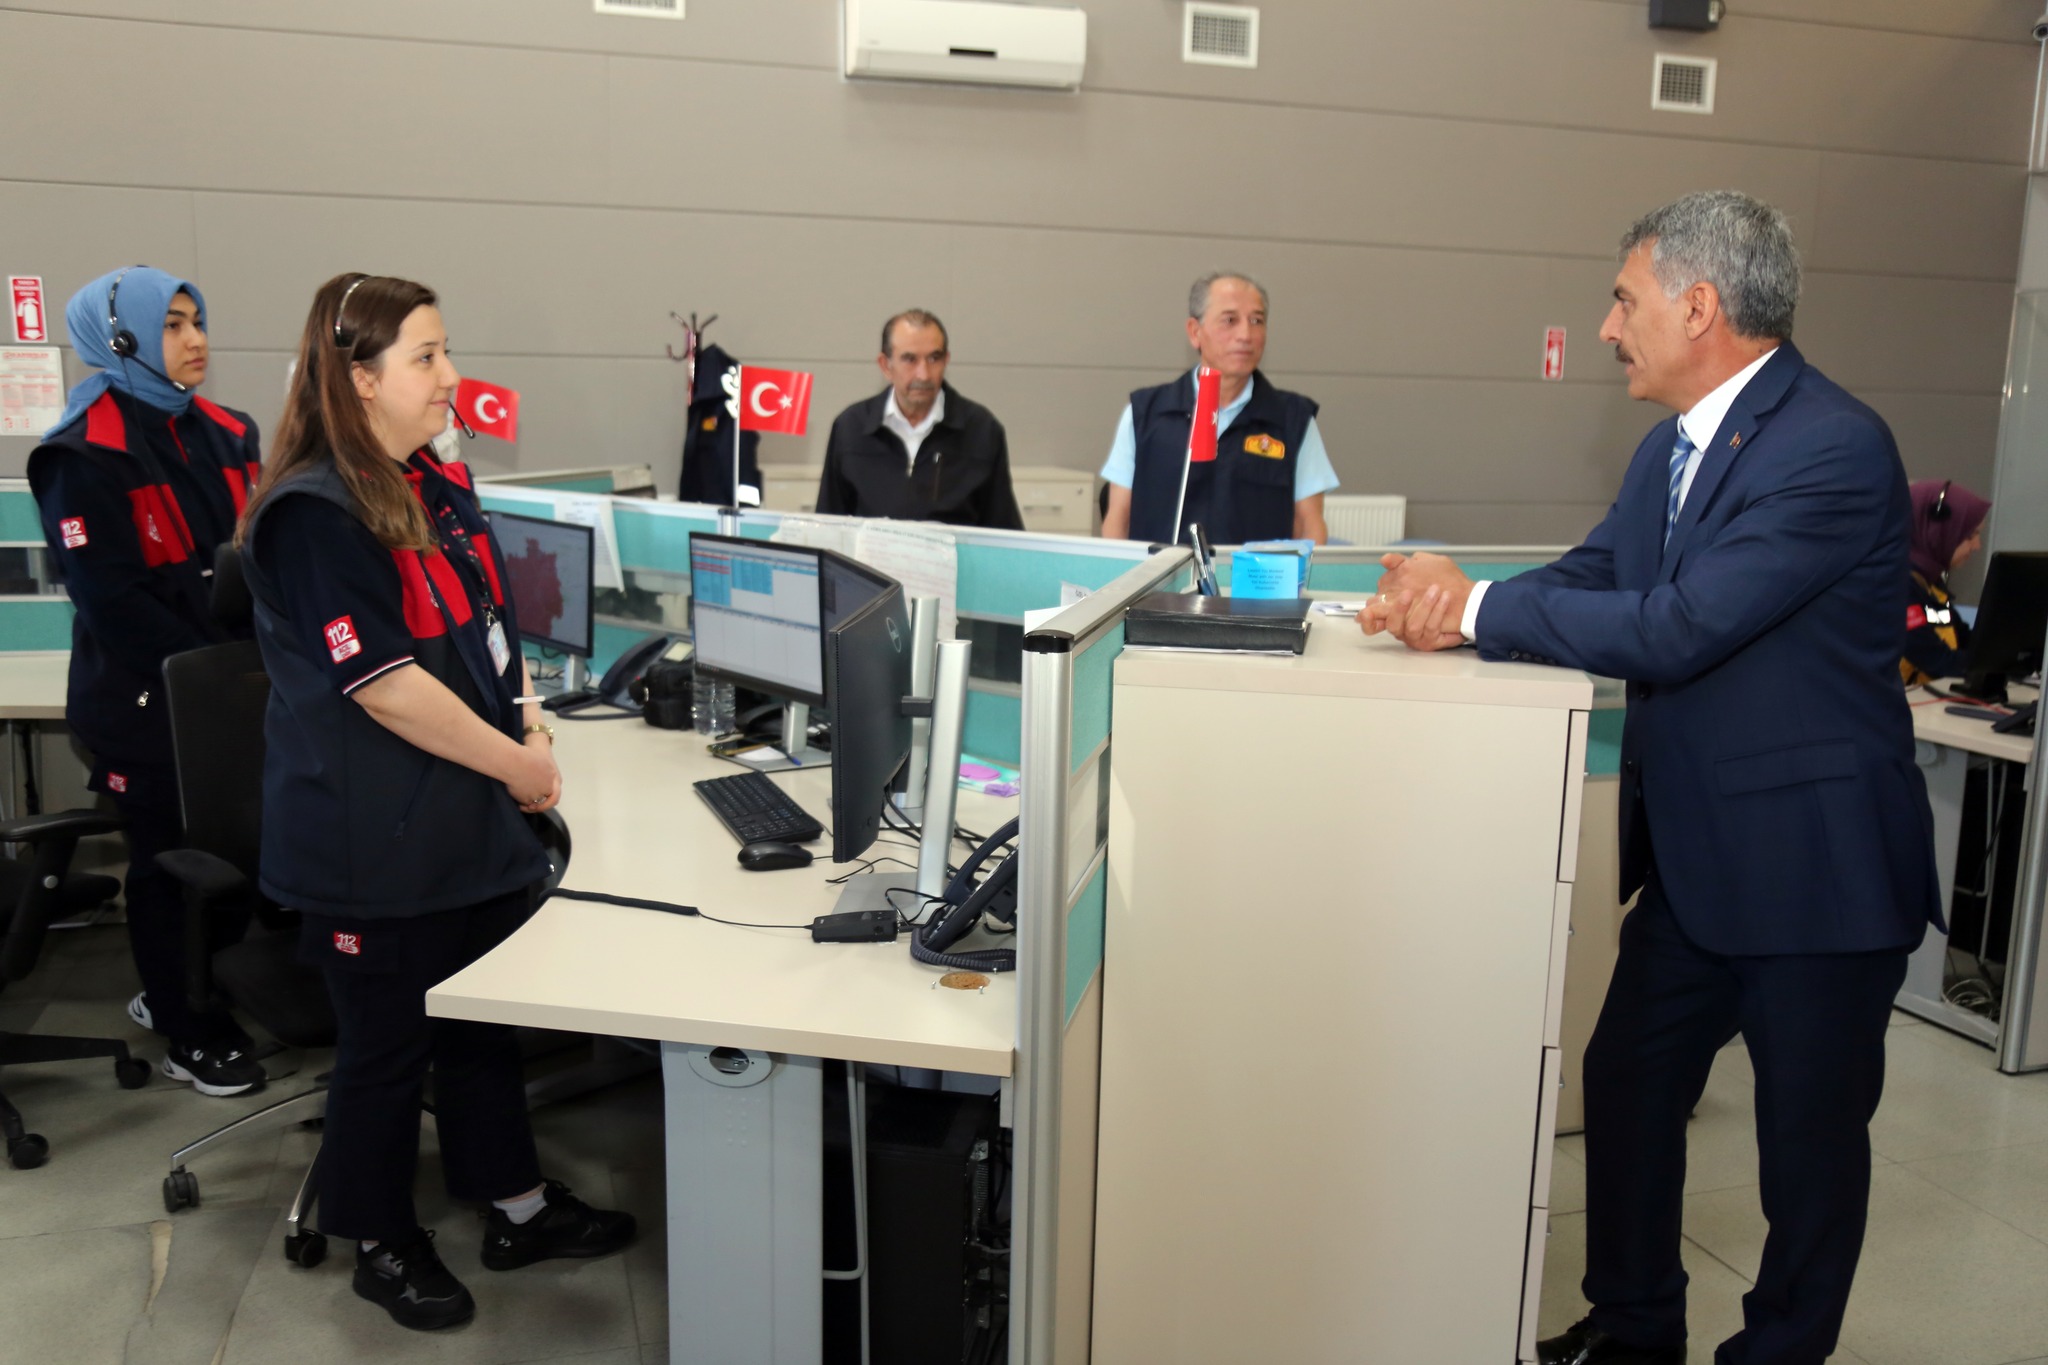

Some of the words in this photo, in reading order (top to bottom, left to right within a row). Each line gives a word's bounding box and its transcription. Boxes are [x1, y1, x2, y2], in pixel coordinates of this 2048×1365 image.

[62, 520, 82, 537] 112
[327, 622, 353, 646] 112
[337, 933, 357, 946] 112
